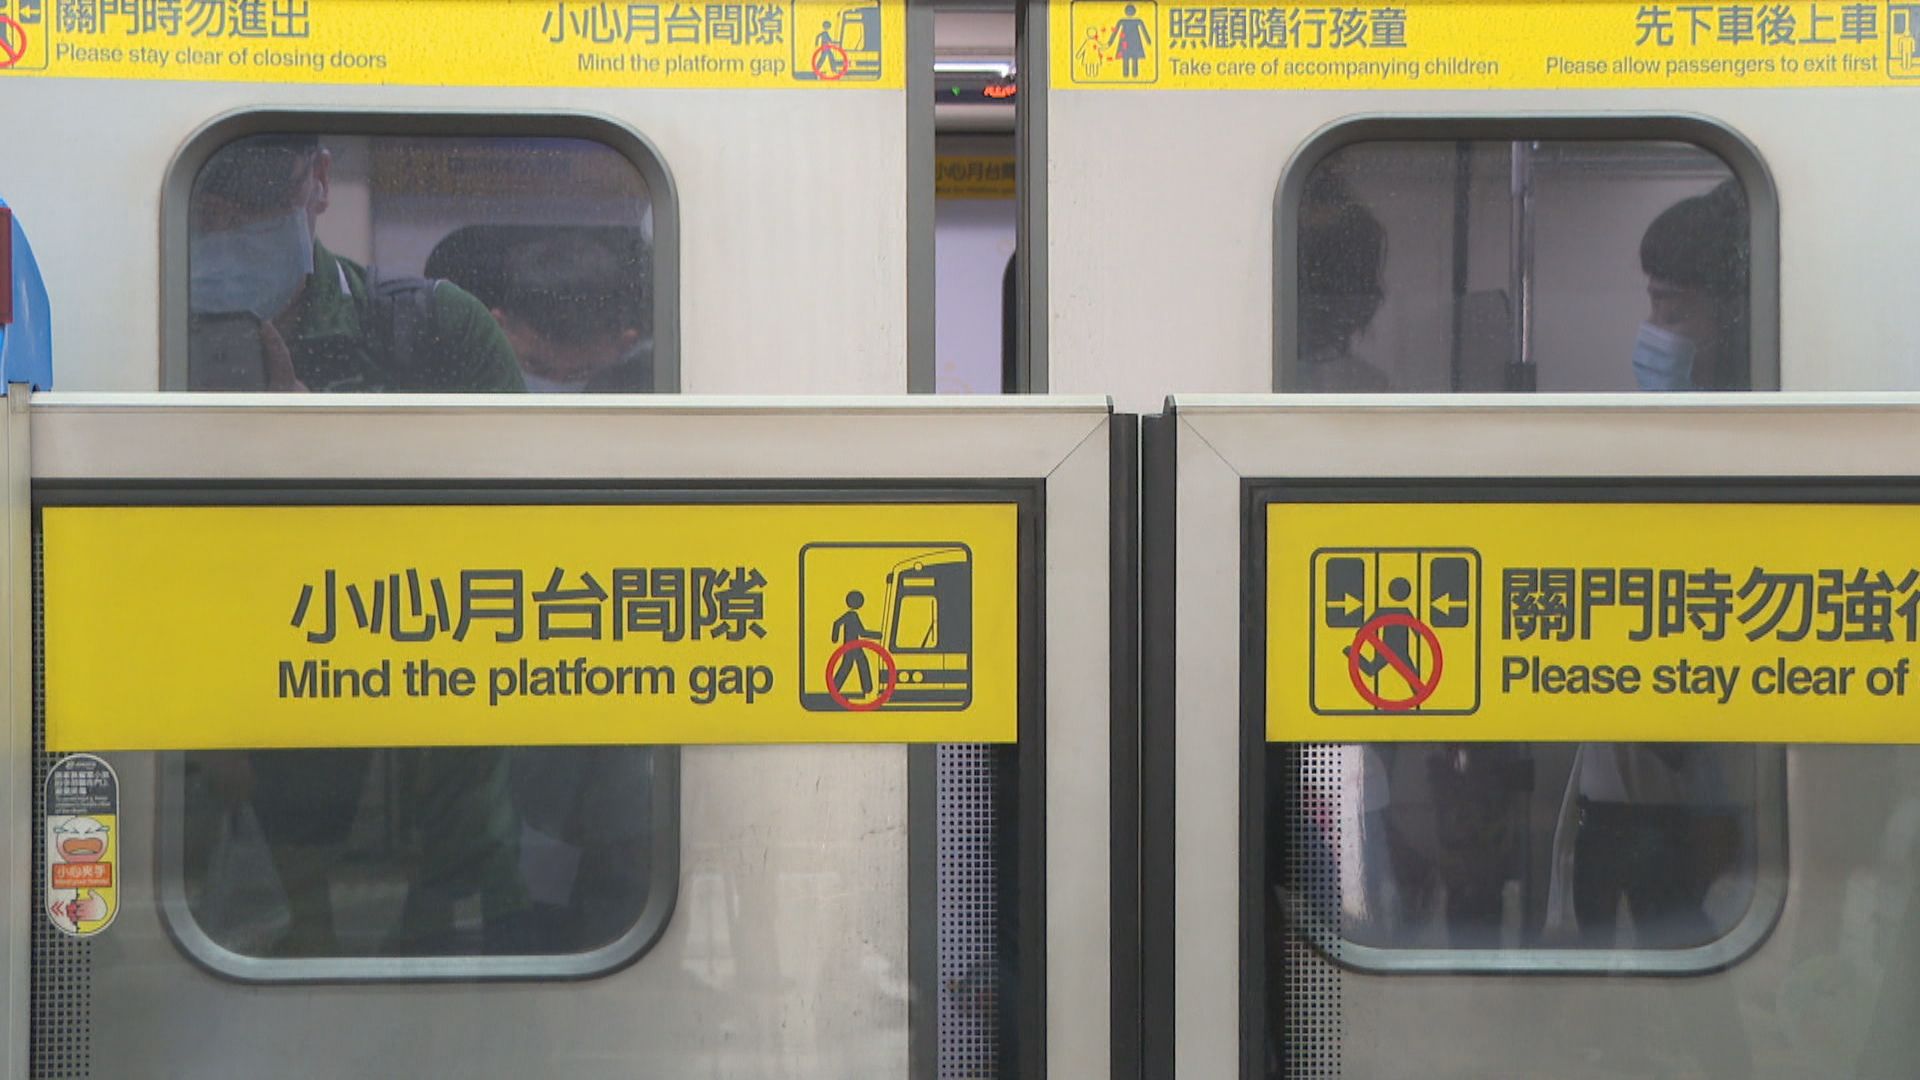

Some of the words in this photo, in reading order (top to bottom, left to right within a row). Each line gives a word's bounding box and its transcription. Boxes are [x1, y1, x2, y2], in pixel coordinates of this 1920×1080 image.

[542, 2, 786, 46] 小心月台間隙
[1168, 7, 1408, 49] 照顧隨行孩童
[1635, 4, 1879, 46] 先下車後上車
[55, 43, 123, 62] Please
[128, 47, 170, 66] stay
[175, 48, 223, 65] clear
[228, 48, 249, 65] of
[253, 51, 326, 71] closing
[329, 52, 387, 68] doors
[577, 53, 625, 71] Mind
[629, 54, 661, 71] the
[665, 54, 745, 75] platform
[750, 58, 786, 76] gap
[1169, 57, 1212, 75] Take
[1216, 60, 1257, 75] care
[1260, 58, 1280, 75] of
[1284, 59, 1420, 79] accompanying
[1424, 58, 1500, 75] children
[1546, 57, 1608, 74] Please
[1612, 57, 1661, 74] allow
[1665, 58, 1776, 77] passengers
[1779, 56, 1800, 73] to
[1804, 54, 1838, 73] exit
[1841, 54, 1879, 72] first
[290, 566, 768, 644] 小心月台間隙
[278, 658, 391, 699] Mind
[402, 658, 477, 698] the
[488, 657, 677, 707] platform
[688, 664, 775, 705] gap
[1501, 656, 1643, 695] Please
[1652, 658, 1742, 705] stay
[1751, 656, 1857, 696] clear
[1866, 657, 1911, 697] of
